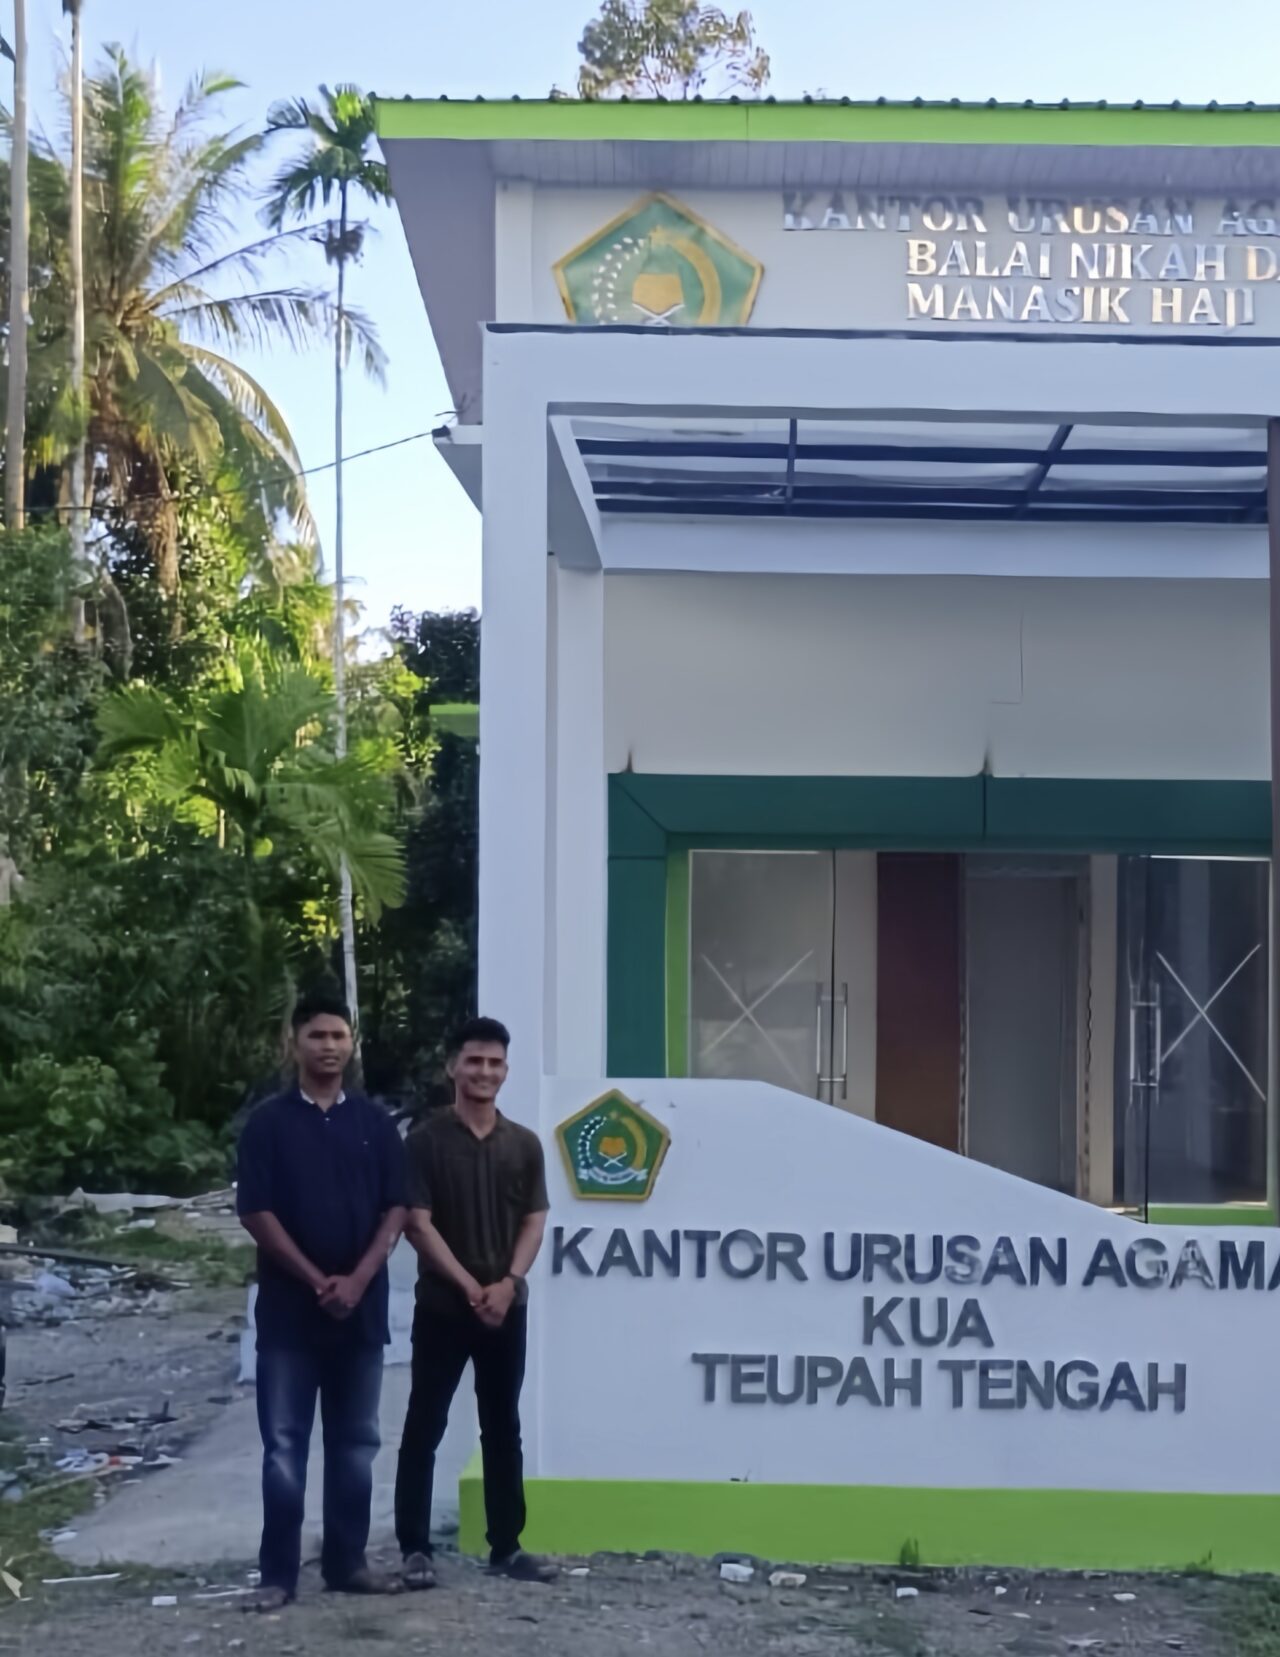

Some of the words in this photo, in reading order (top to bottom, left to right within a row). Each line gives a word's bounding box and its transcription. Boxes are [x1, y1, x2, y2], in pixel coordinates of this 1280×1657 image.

[783, 194, 988, 232] KANTOR
[1006, 196, 1193, 235] URUSAN
[906, 239, 1051, 279] BALAI
[1071, 242, 1226, 282] NIKAH
[906, 283, 1131, 323] MANASIK
[1152, 287, 1255, 327] HAJI
[552, 1226, 808, 1281] KANTOR
[823, 1232, 1067, 1285] URUSAN
[862, 1296, 995, 1348] KUA
[691, 1352, 922, 1407] TEUPAH
[937, 1359, 1187, 1413] TENGAH
